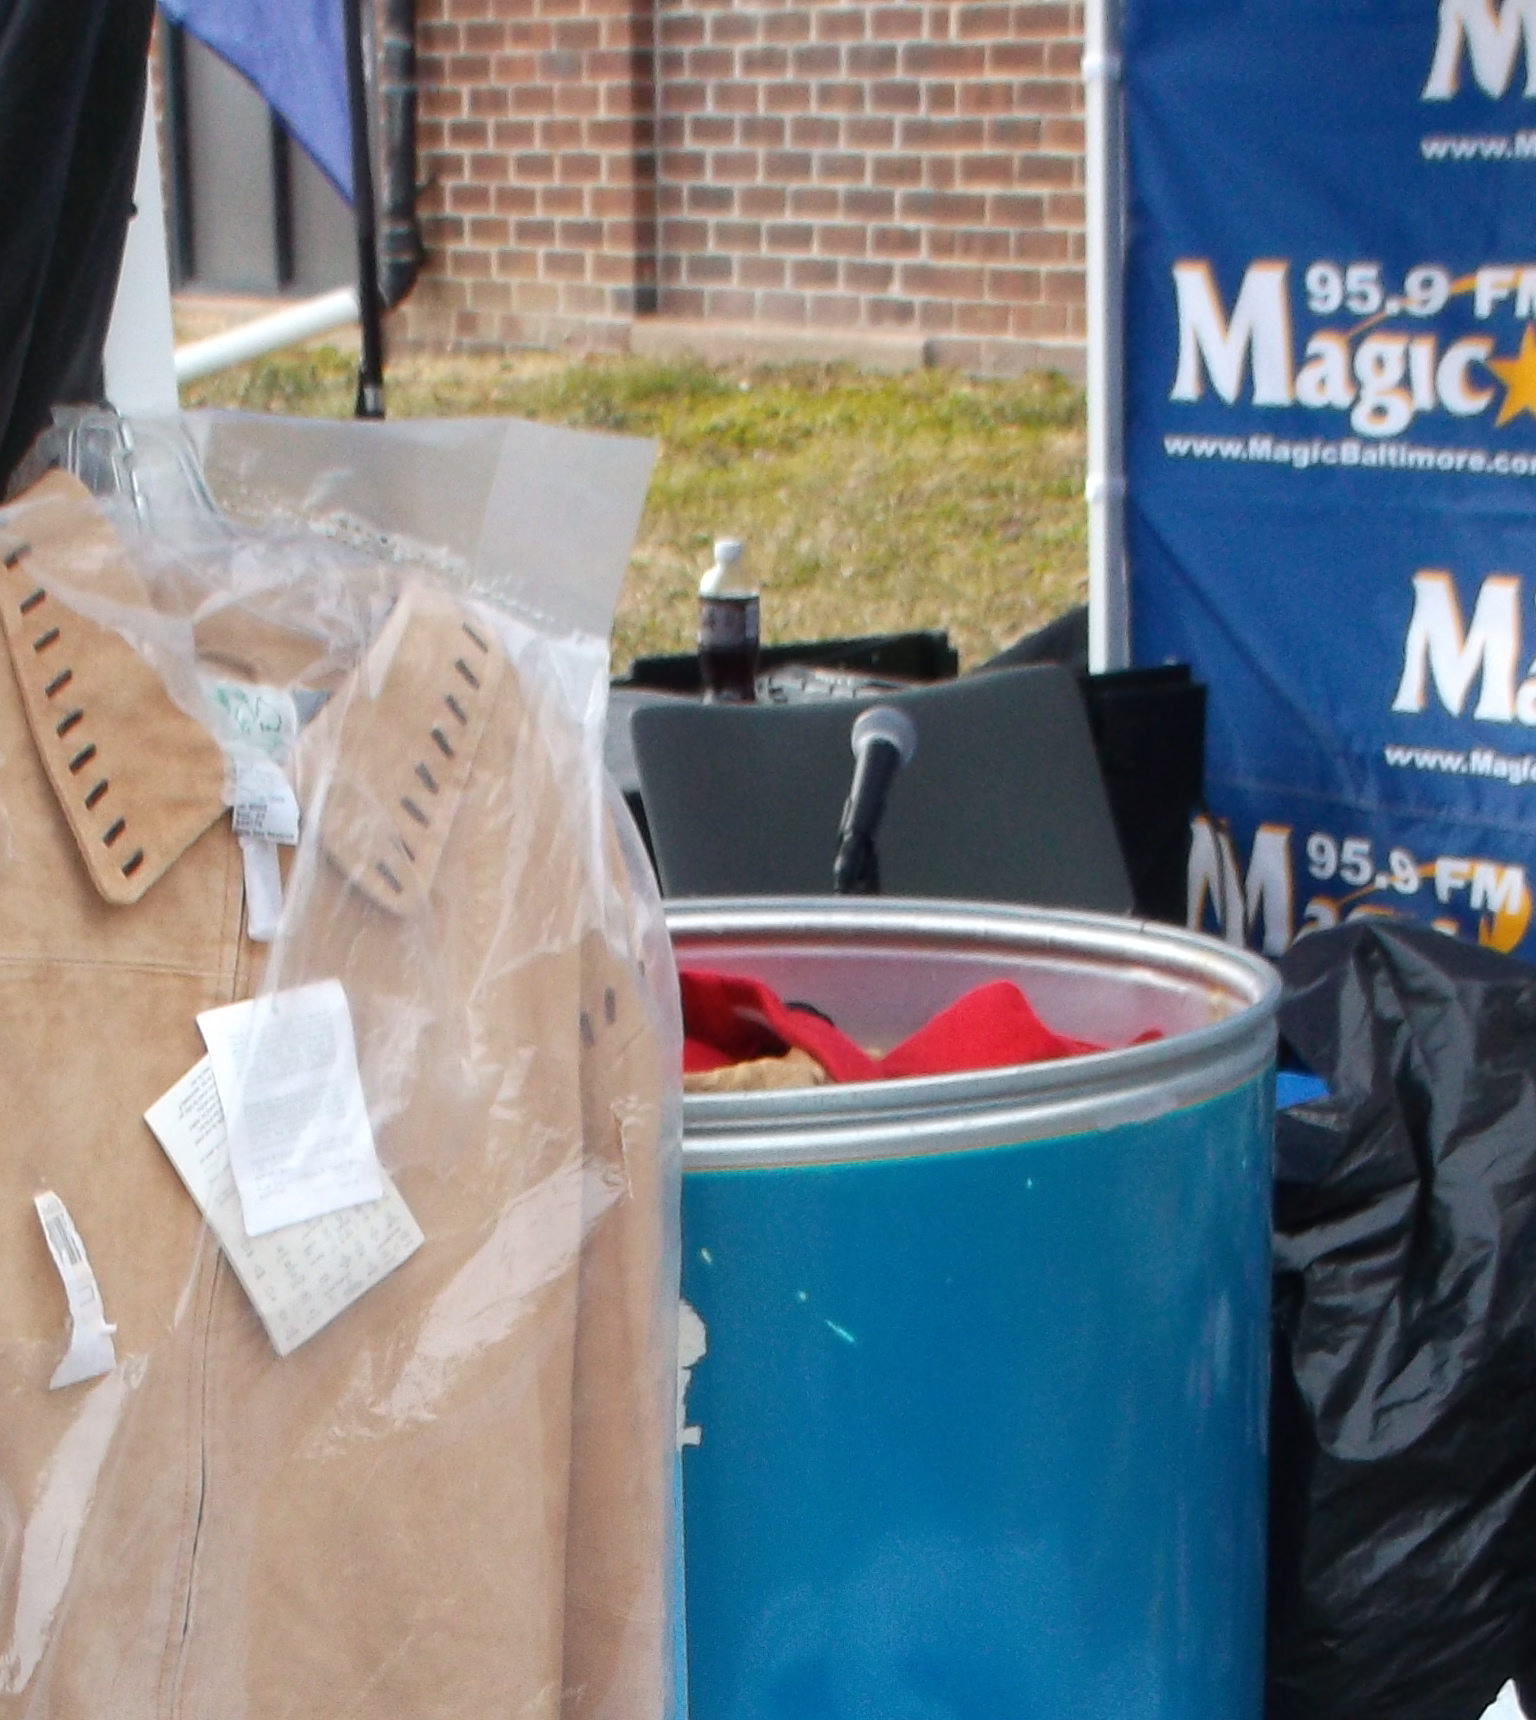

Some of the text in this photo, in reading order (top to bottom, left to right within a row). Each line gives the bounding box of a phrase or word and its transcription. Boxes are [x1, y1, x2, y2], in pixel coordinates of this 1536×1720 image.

[1305, 263, 1450, 317] 95.9
[1170, 258, 1497, 437] Magic
[1306, 831, 1421, 895] 95.9
[1434, 856, 1526, 916] FM
